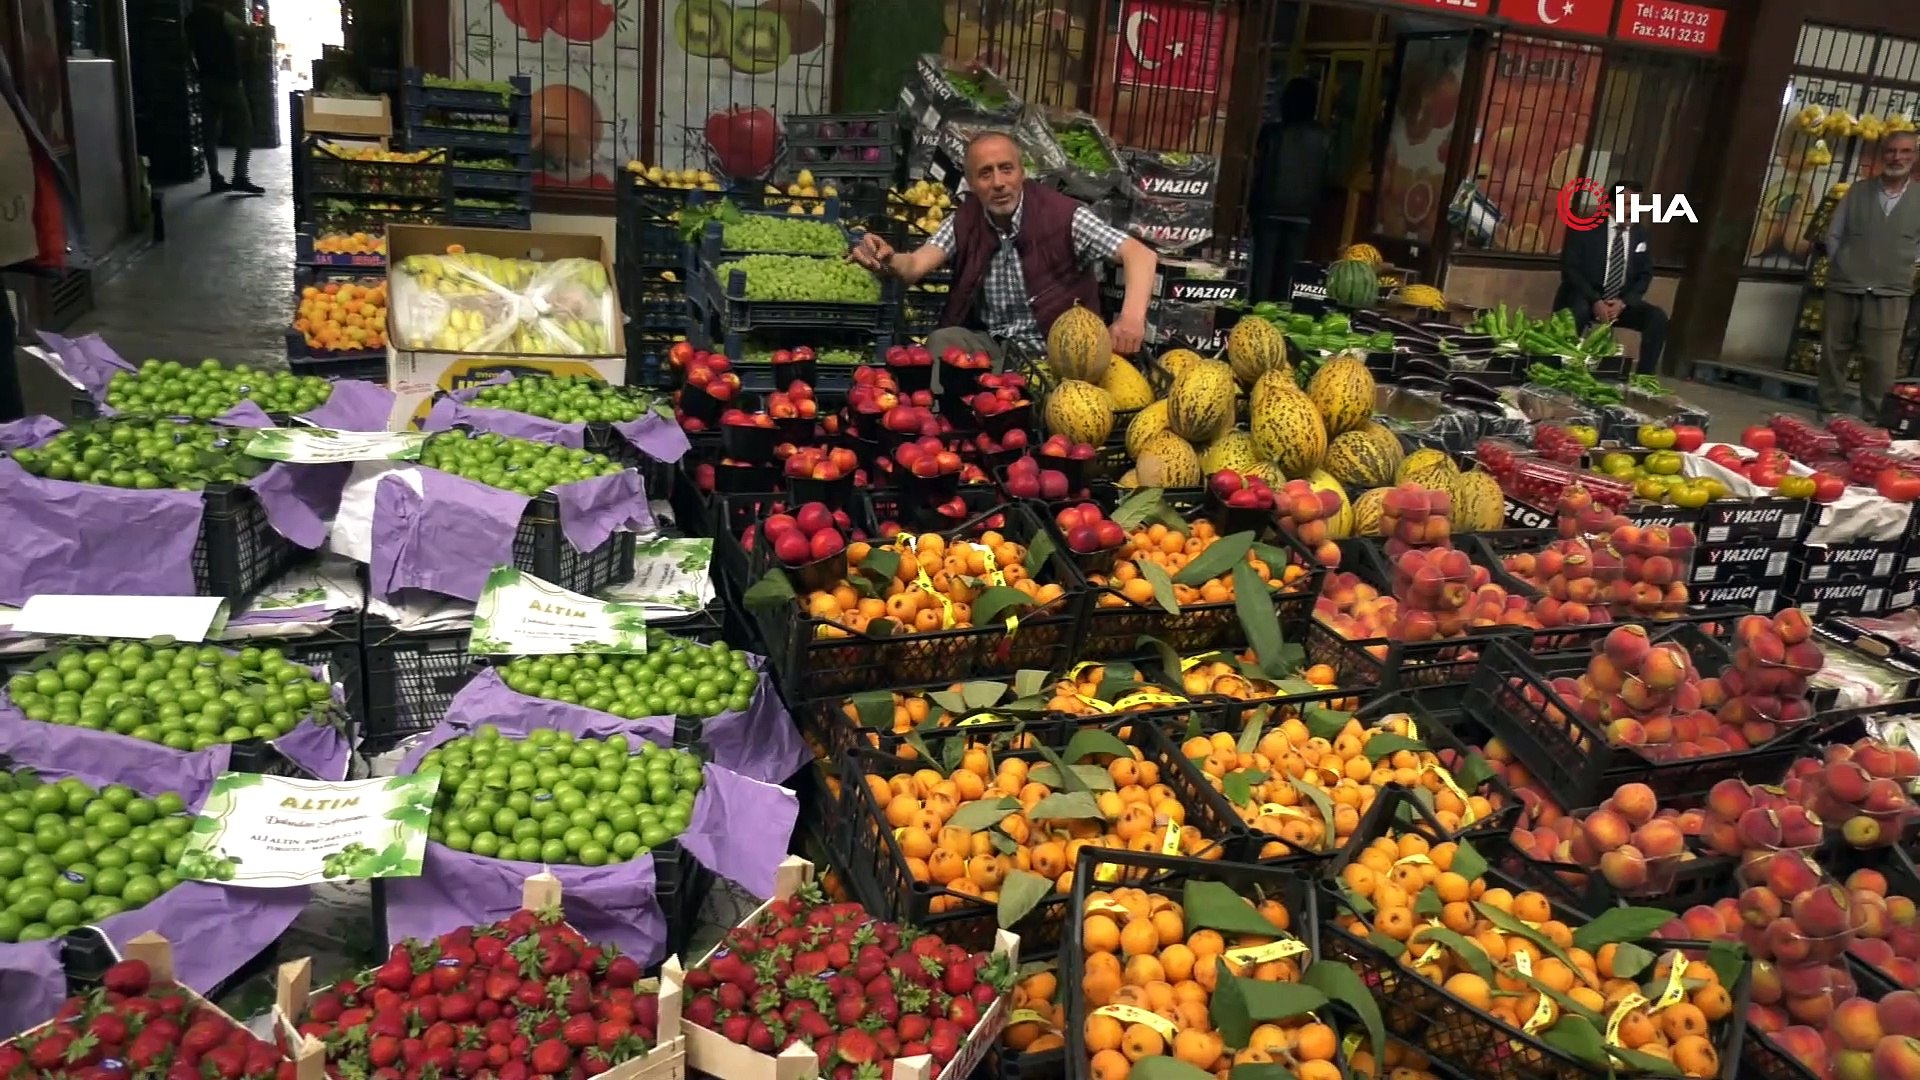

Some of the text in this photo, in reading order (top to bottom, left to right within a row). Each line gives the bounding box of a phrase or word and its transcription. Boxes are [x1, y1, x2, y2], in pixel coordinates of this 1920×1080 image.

[1661, 8, 1680, 21] 341
[1681, 10, 1695, 24] 32
[1695, 13, 1709, 26] 32
[1632, 21, 1706, 43] Fax: 341 32 33
[1153, 179, 1209, 195] YAZICI
[1185, 287, 1238, 299] YAZICI
[1734, 509, 1783, 524] YAZICI
[1721, 547, 1770, 562] YAZICI
[1834, 548, 1879, 562] YAZICI
[1711, 586, 1758, 601] YAZICI
[1823, 585, 1868, 599] YAZICI
[280, 796, 361, 810] ALTIN
